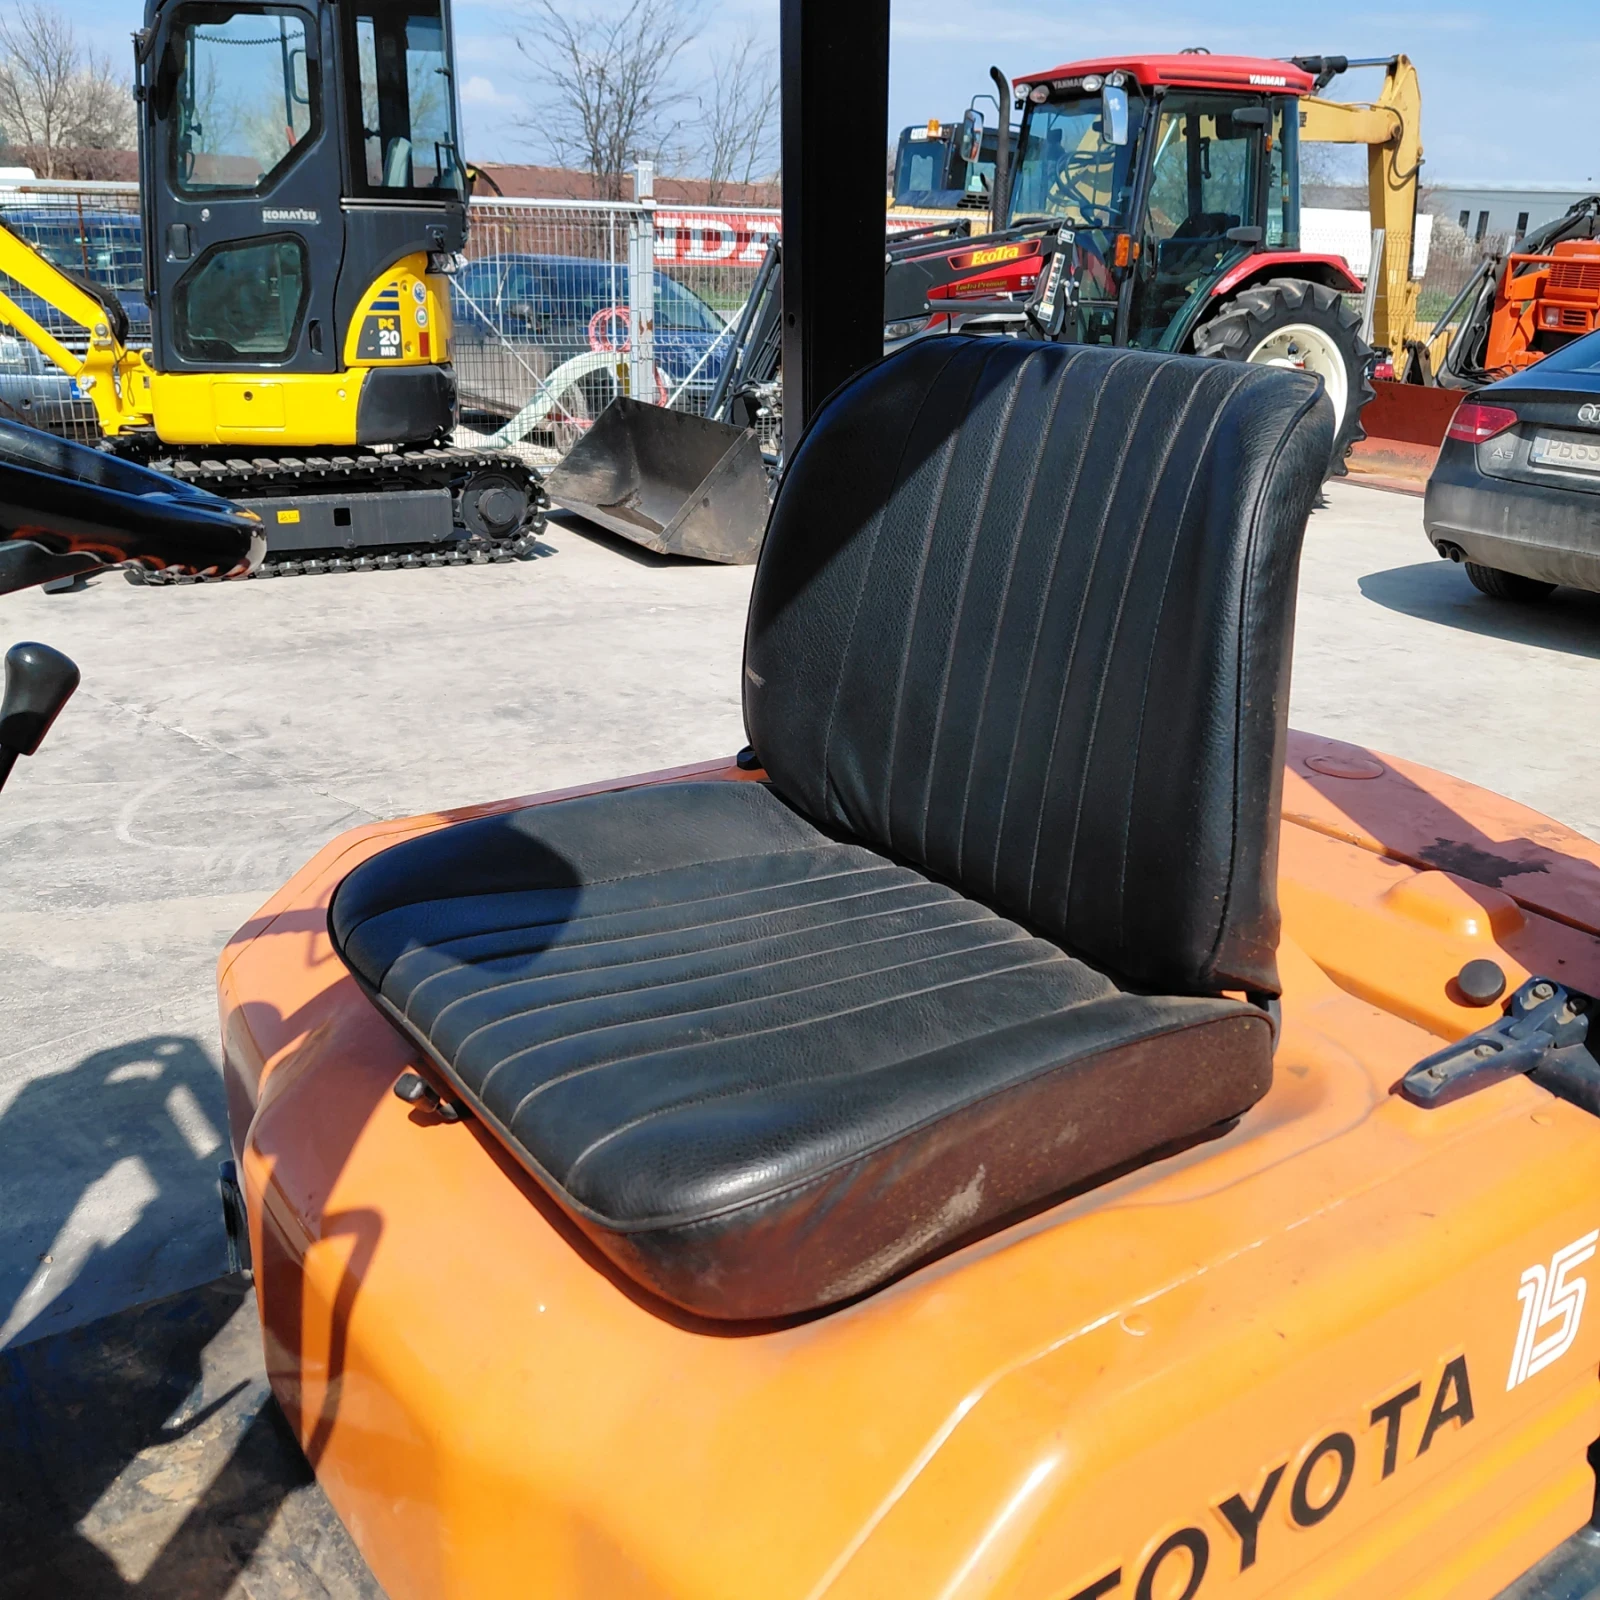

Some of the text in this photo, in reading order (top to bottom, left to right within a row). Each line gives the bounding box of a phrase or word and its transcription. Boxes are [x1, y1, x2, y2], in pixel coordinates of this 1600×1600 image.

[1249, 74, 1287, 87] YANMAR
[262, 208, 317, 221] KOMATSU
[970, 245, 1020, 267] EcoTra
[378, 318, 395, 330] PC
[379, 330, 400, 345] 20
[380, 346, 397, 356] MR
[1491, 447, 1514, 460] A5
[1506, 1229, 1600, 1392] 15
